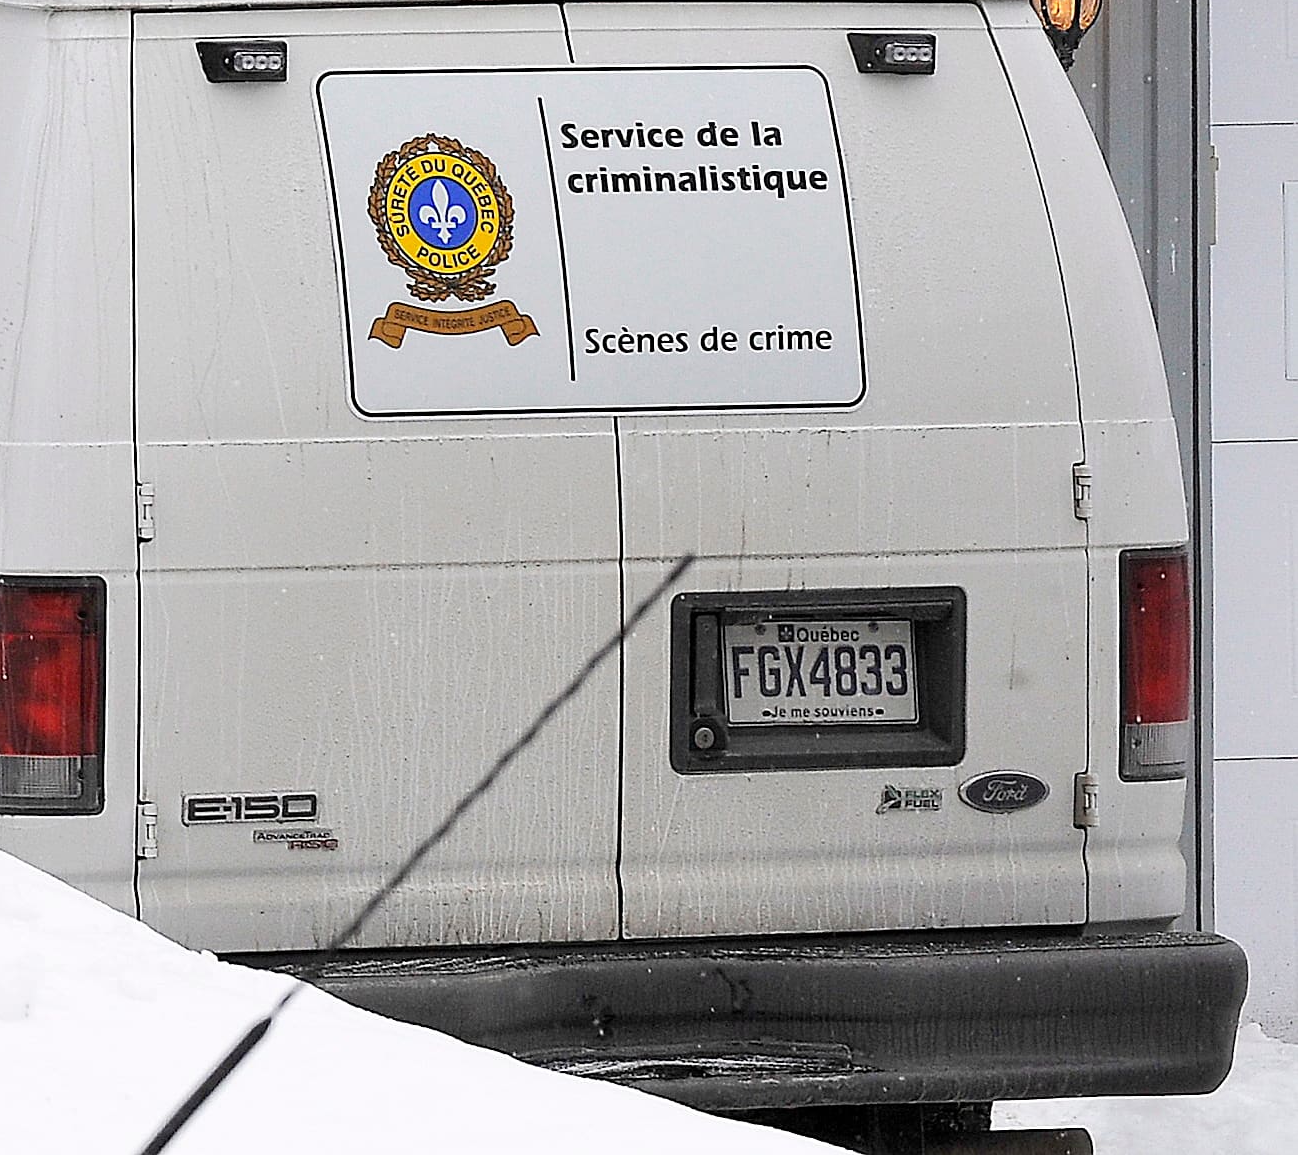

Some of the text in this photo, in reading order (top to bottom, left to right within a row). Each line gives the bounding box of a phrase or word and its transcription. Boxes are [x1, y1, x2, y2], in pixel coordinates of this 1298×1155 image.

[560, 120, 783, 149] Service de la
[567, 165, 828, 198] criminalistique
[420, 158, 446, 174] DU
[451, 163, 495, 234] QUÉBEC
[417, 244, 481, 269] POLICE
[394, 309, 430, 326] SERVICE
[479, 306, 511, 325] JUSTICE
[584, 326, 832, 355] Scènes de crime
[796, 626, 860, 643] Québec
[731, 644, 908, 699] FGX4833
[771, 704, 874, 718] Je me souviens
[982, 778, 1029, 803] Ford
[187, 794, 317, 819] E-150
[905, 799, 939, 808] FUEL
